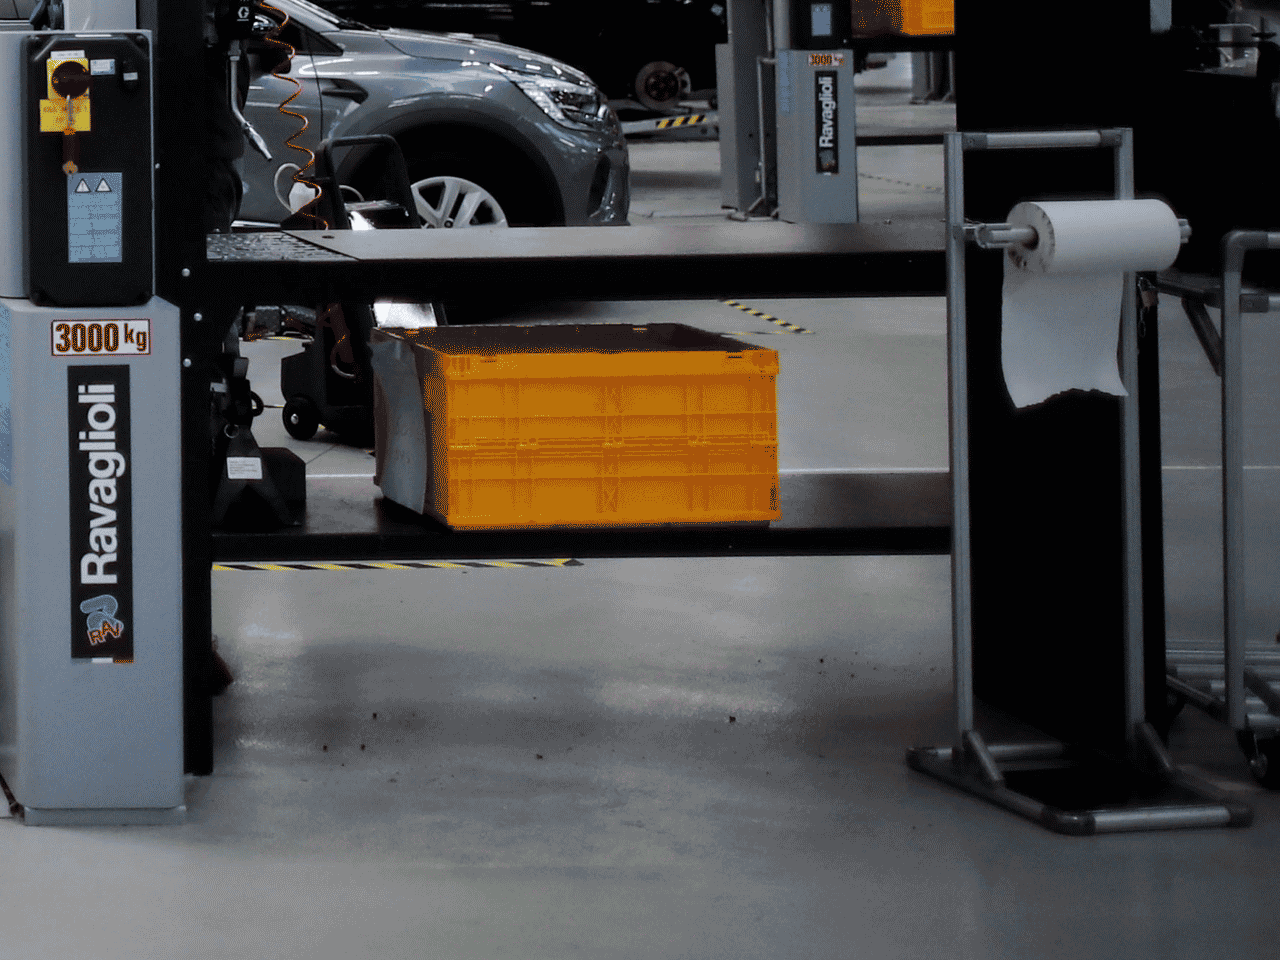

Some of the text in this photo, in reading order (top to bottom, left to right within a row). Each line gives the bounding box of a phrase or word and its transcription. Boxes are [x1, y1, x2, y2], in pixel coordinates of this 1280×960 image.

[818, 76, 836, 148] Ravaglioli
[55, 323, 147, 353] 3000 kg
[77, 383, 127, 585] Ravaglioli
